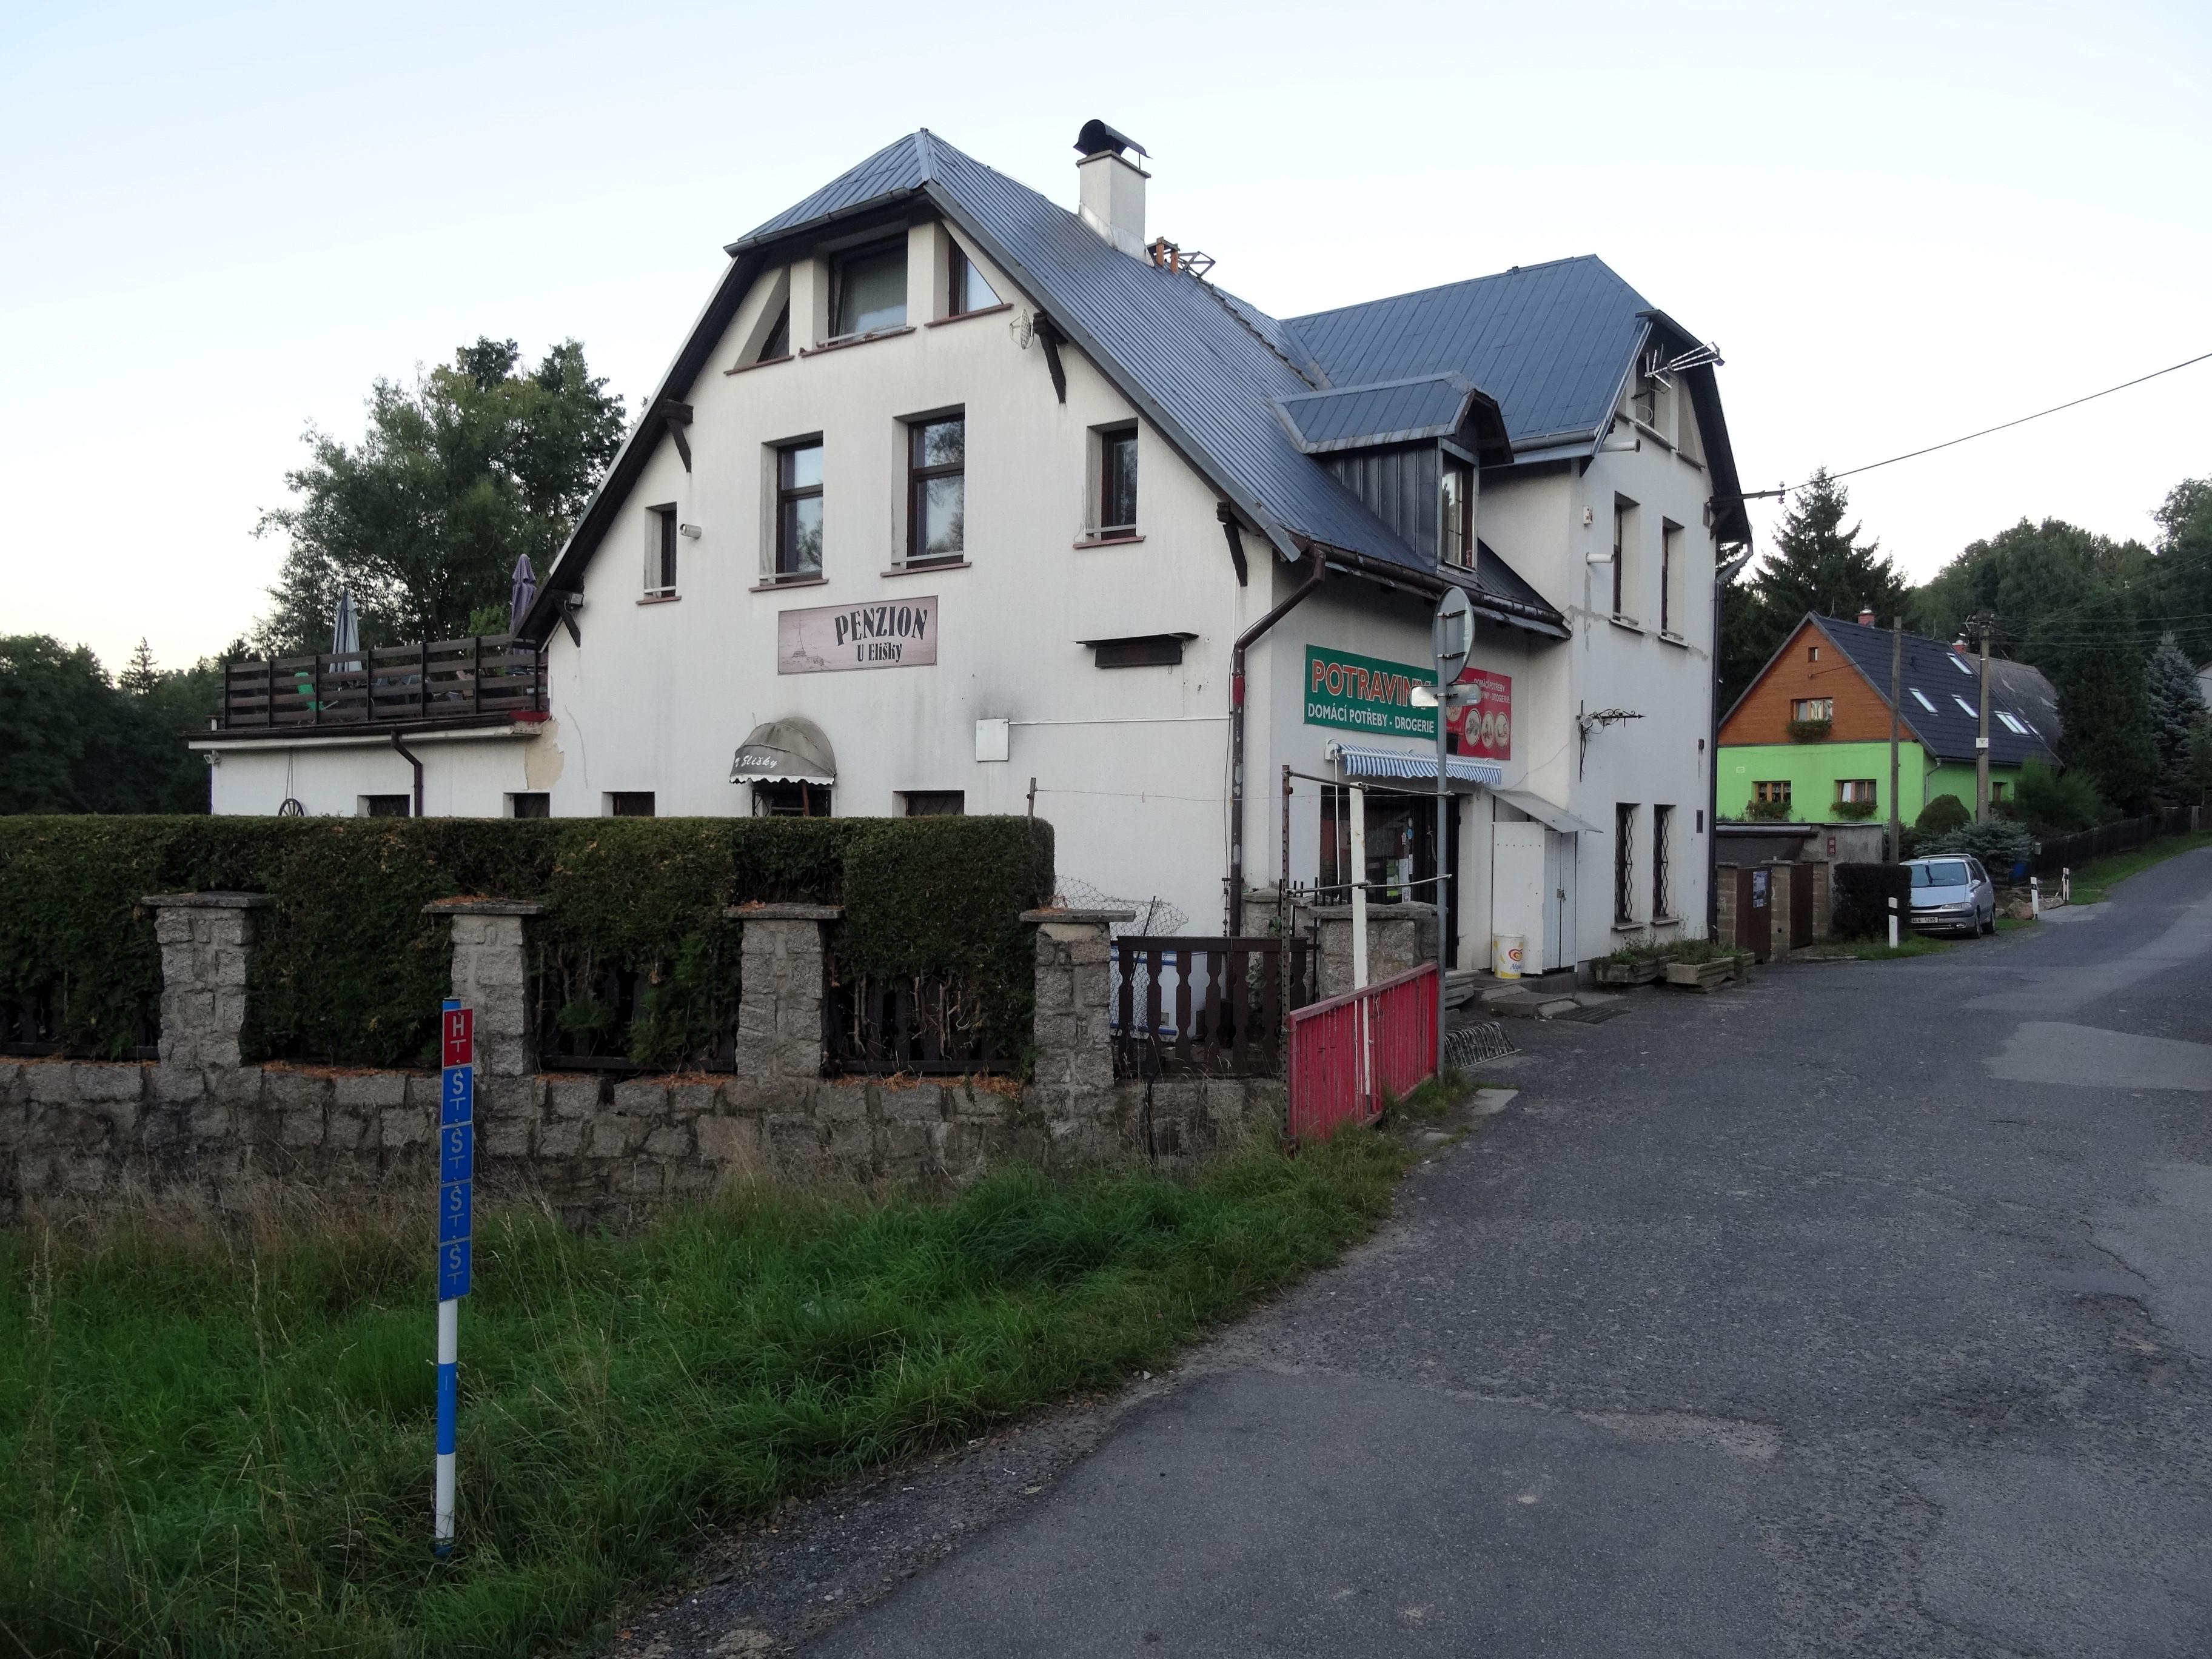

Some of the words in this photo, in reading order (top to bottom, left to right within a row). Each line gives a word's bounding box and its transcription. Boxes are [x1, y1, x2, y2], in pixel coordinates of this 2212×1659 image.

[834, 606, 928, 646] PENZION
[857, 645, 864, 662] U
[868, 642, 902, 663] Elišky
[1312, 659, 1432, 710] POTRAVIN
[1308, 702, 1347, 722] DOMÁCÍ
[1349, 708, 1387, 727] POTŘEBY
[1395, 716, 1435, 733] DROGERIE
[741, 755, 777, 769] Elišky
[453, 1014, 464, 1037] H
